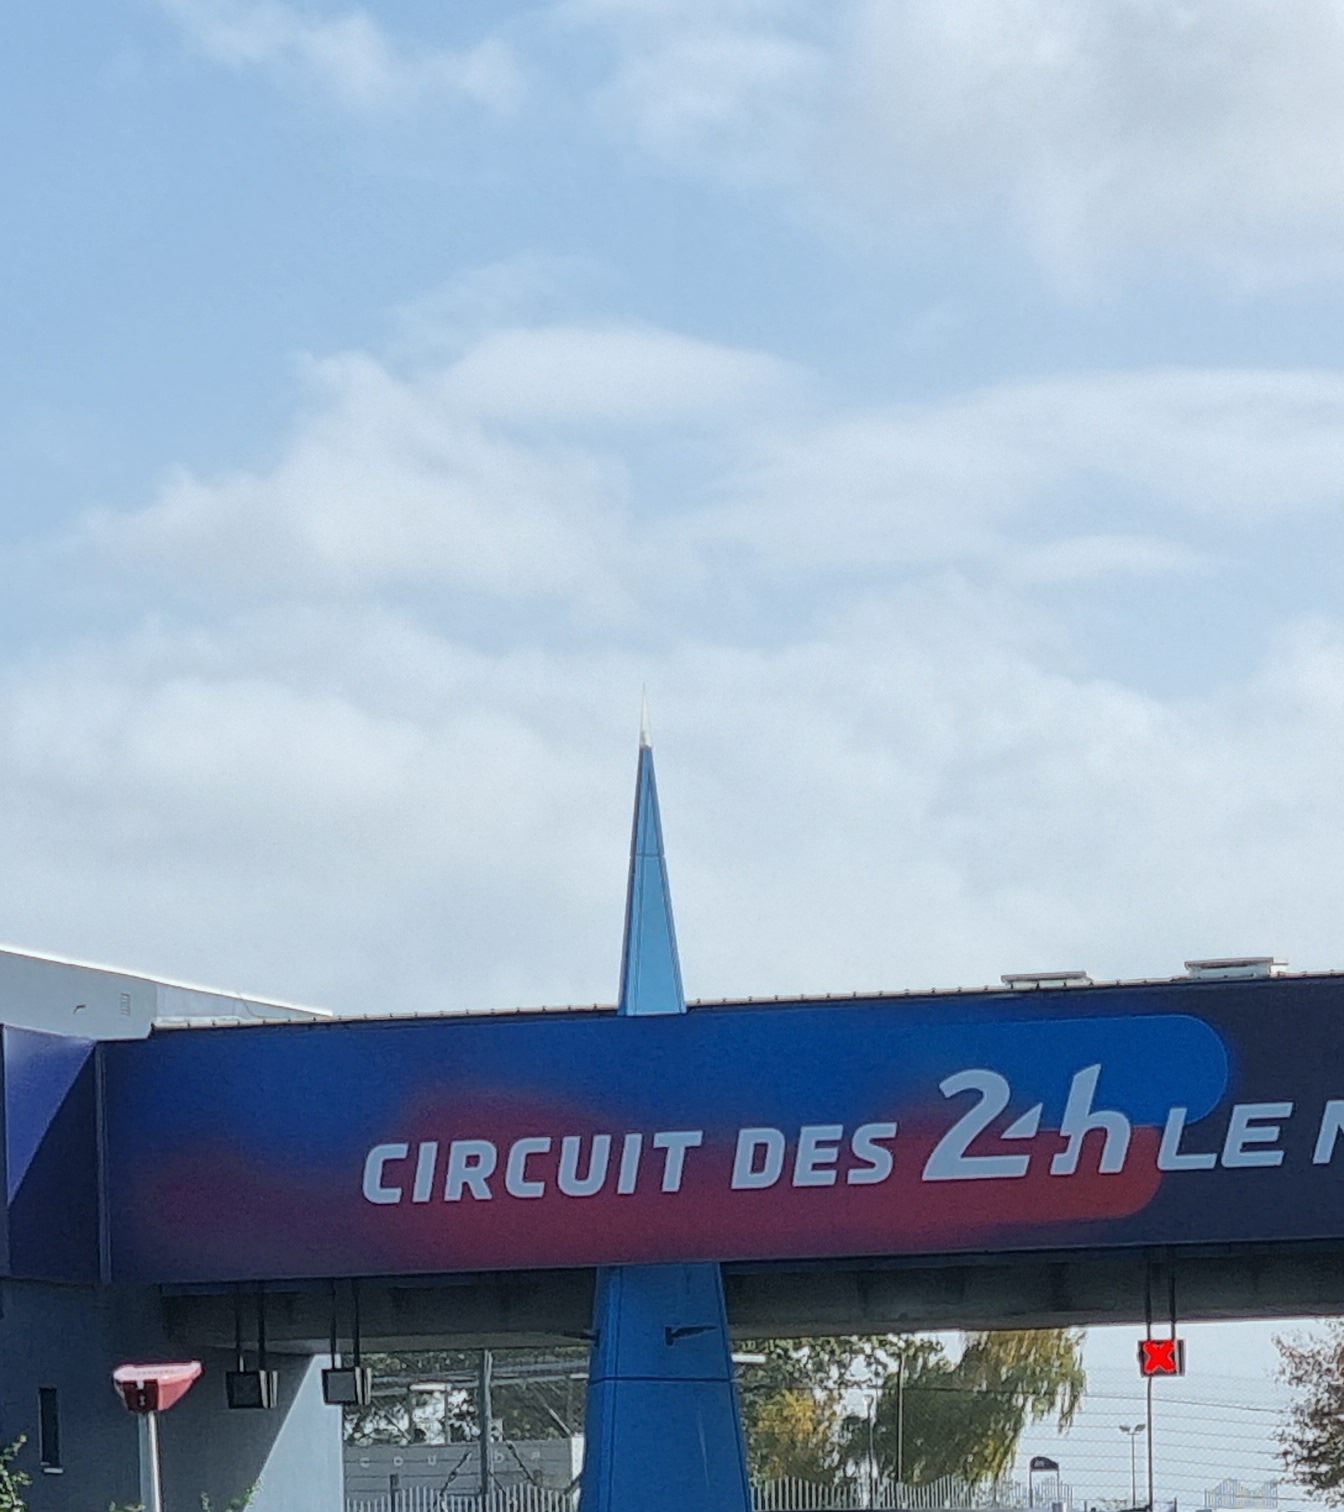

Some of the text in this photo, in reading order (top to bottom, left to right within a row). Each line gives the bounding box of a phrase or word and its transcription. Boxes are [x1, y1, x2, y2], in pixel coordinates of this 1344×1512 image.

[361, 1130, 704, 1205] CIRCUIT
[730, 1122, 899, 1190] DES
[921, 1062, 1132, 1183] 24h
[1156, 1101, 1294, 1172] LE
